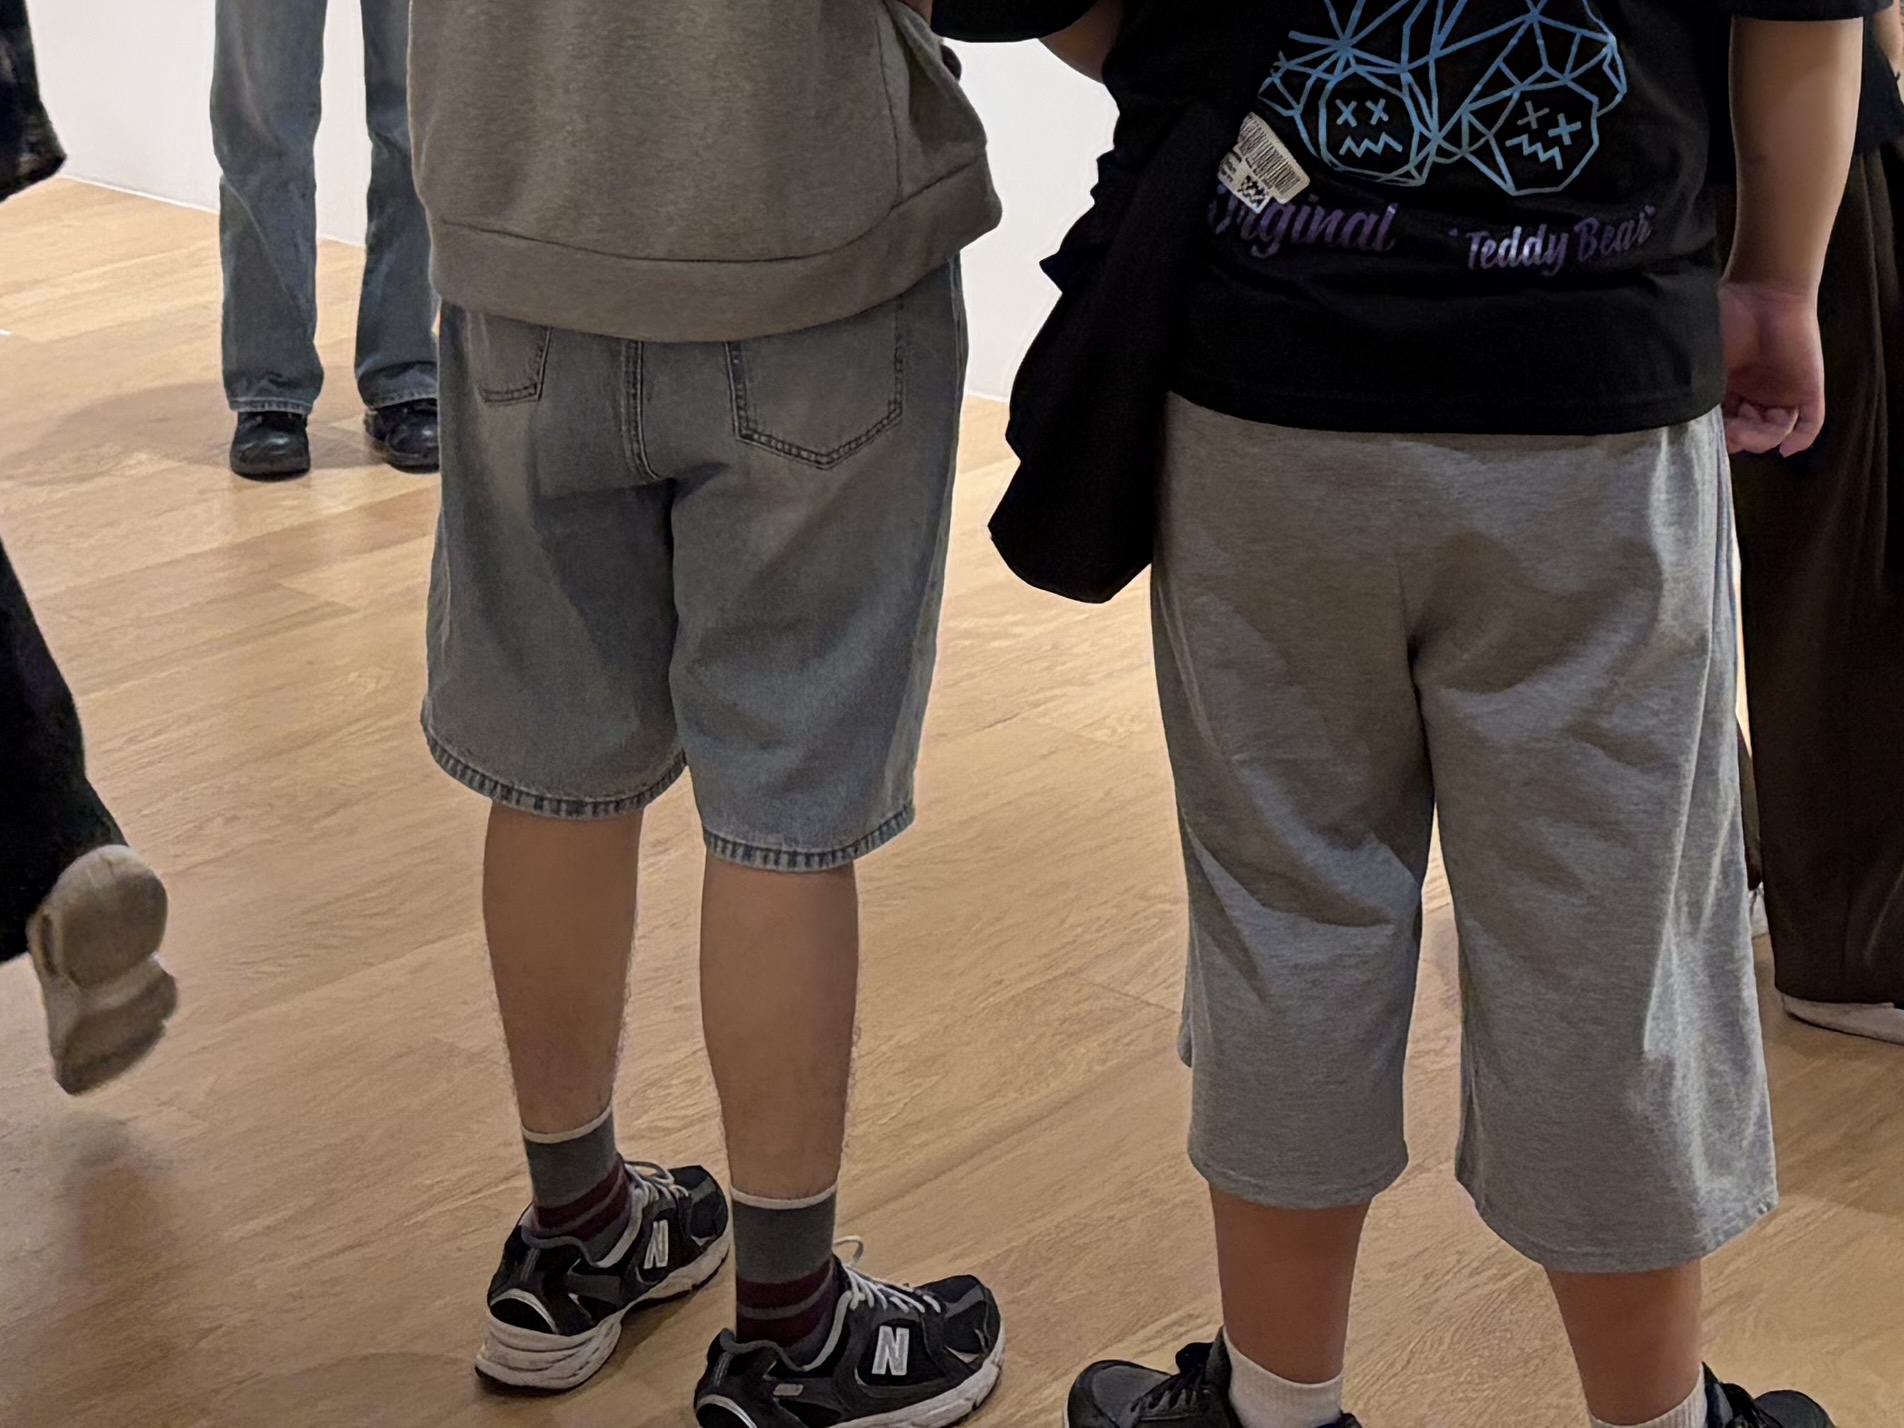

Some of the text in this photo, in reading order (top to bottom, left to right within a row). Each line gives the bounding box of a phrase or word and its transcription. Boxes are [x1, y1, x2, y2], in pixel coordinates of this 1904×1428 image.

[1465, 223, 1570, 276] Teddy
[1574, 211, 1652, 262] Bear
[643, 1218, 669, 1270] N
[871, 1325, 910, 1376] N
